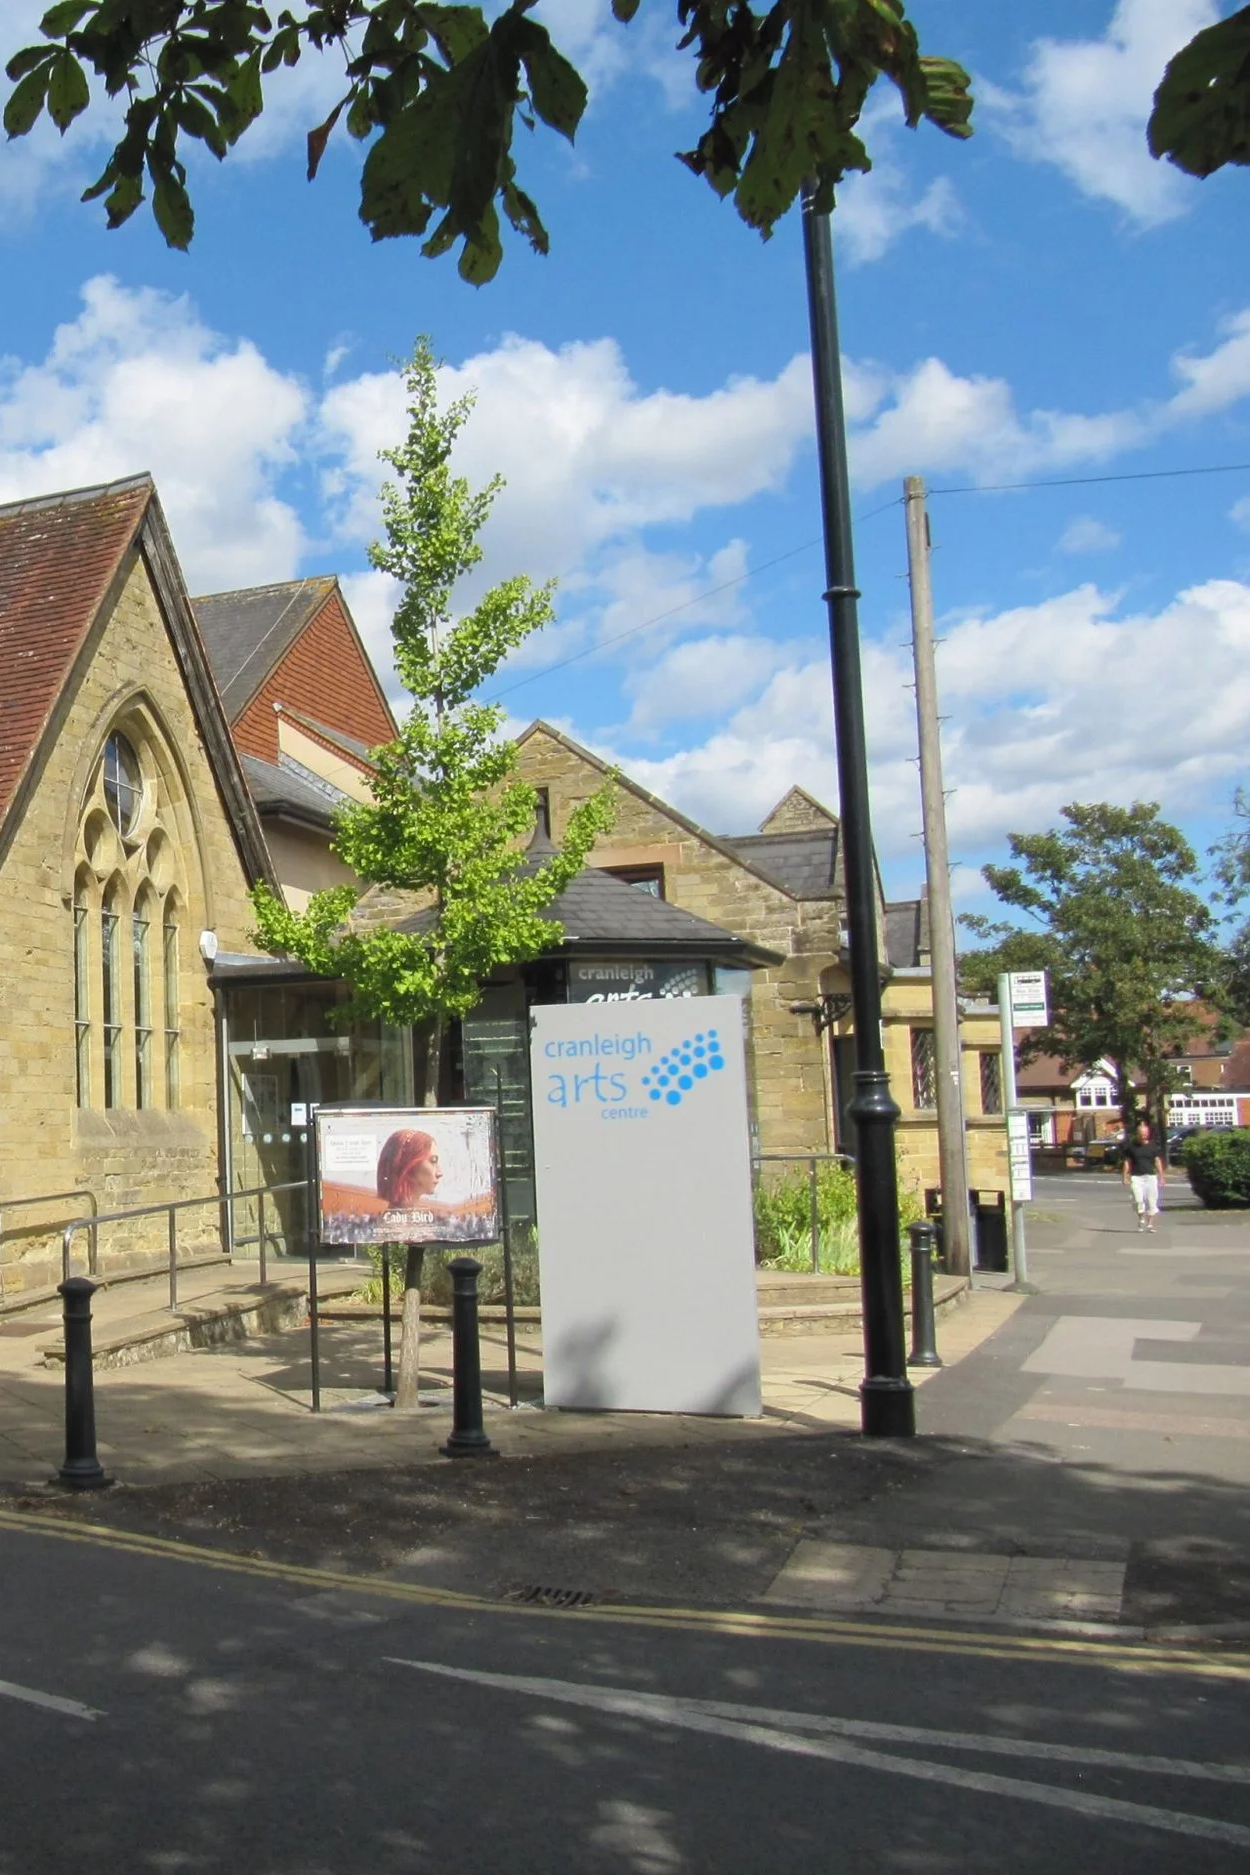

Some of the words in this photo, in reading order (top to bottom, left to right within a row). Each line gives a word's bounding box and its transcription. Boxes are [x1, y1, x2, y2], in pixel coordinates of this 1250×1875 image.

[578, 964, 654, 984] cranleigh
[544, 1031, 652, 1060] cranleigh
[547, 1062, 628, 1107] arts
[600, 1105, 650, 1120] centre
[383, 1210, 408, 1224] Lady
[411, 1210, 434, 1224] Bird
